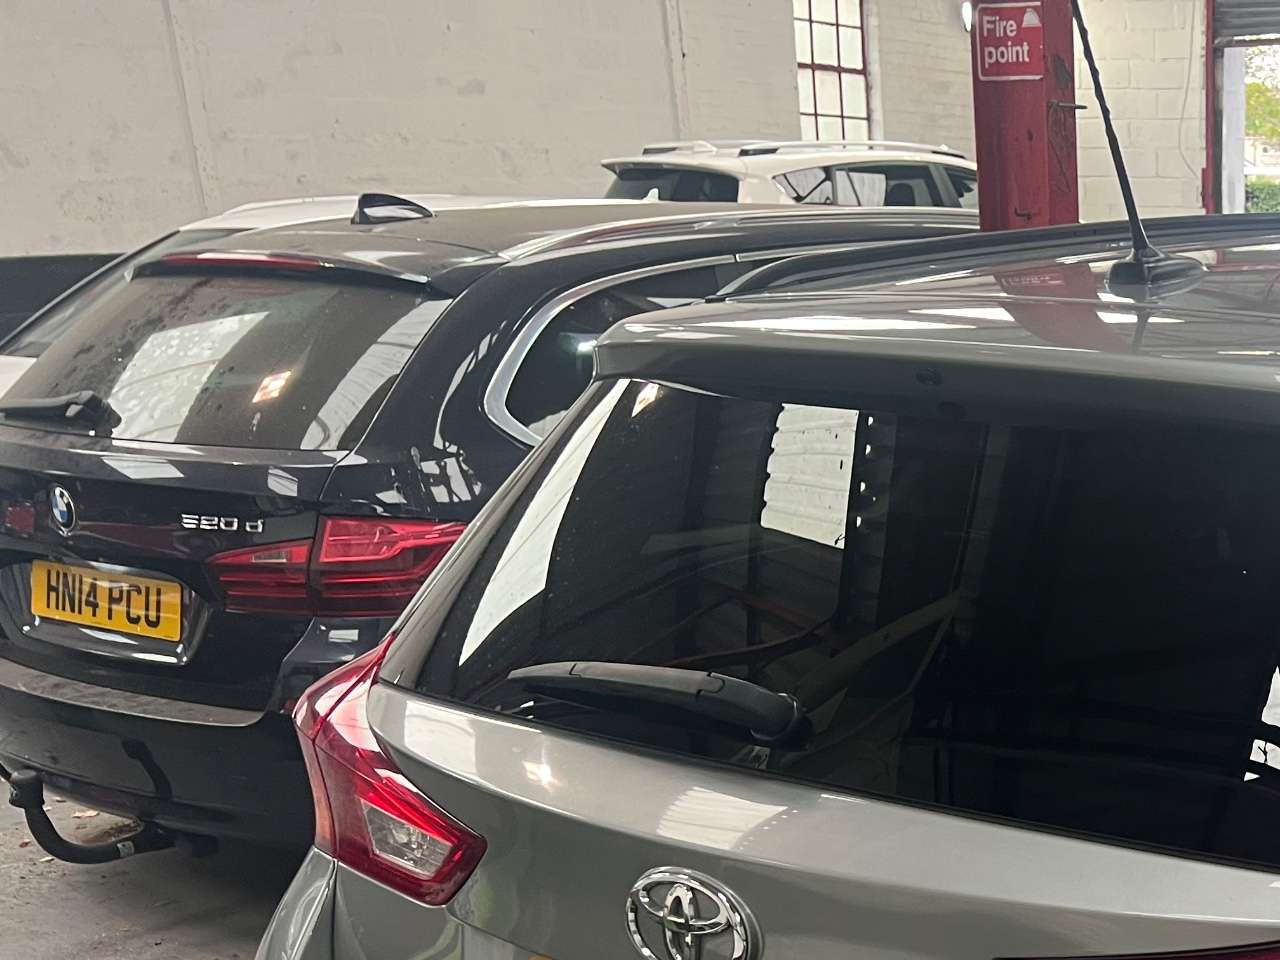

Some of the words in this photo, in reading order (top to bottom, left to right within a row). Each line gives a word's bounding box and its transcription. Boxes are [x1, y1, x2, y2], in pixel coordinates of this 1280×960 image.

[982, 15, 1018, 38] Fire
[984, 41, 1030, 69] point
[46, 568, 99, 618] HN14
[107, 579, 162, 629] PCU
